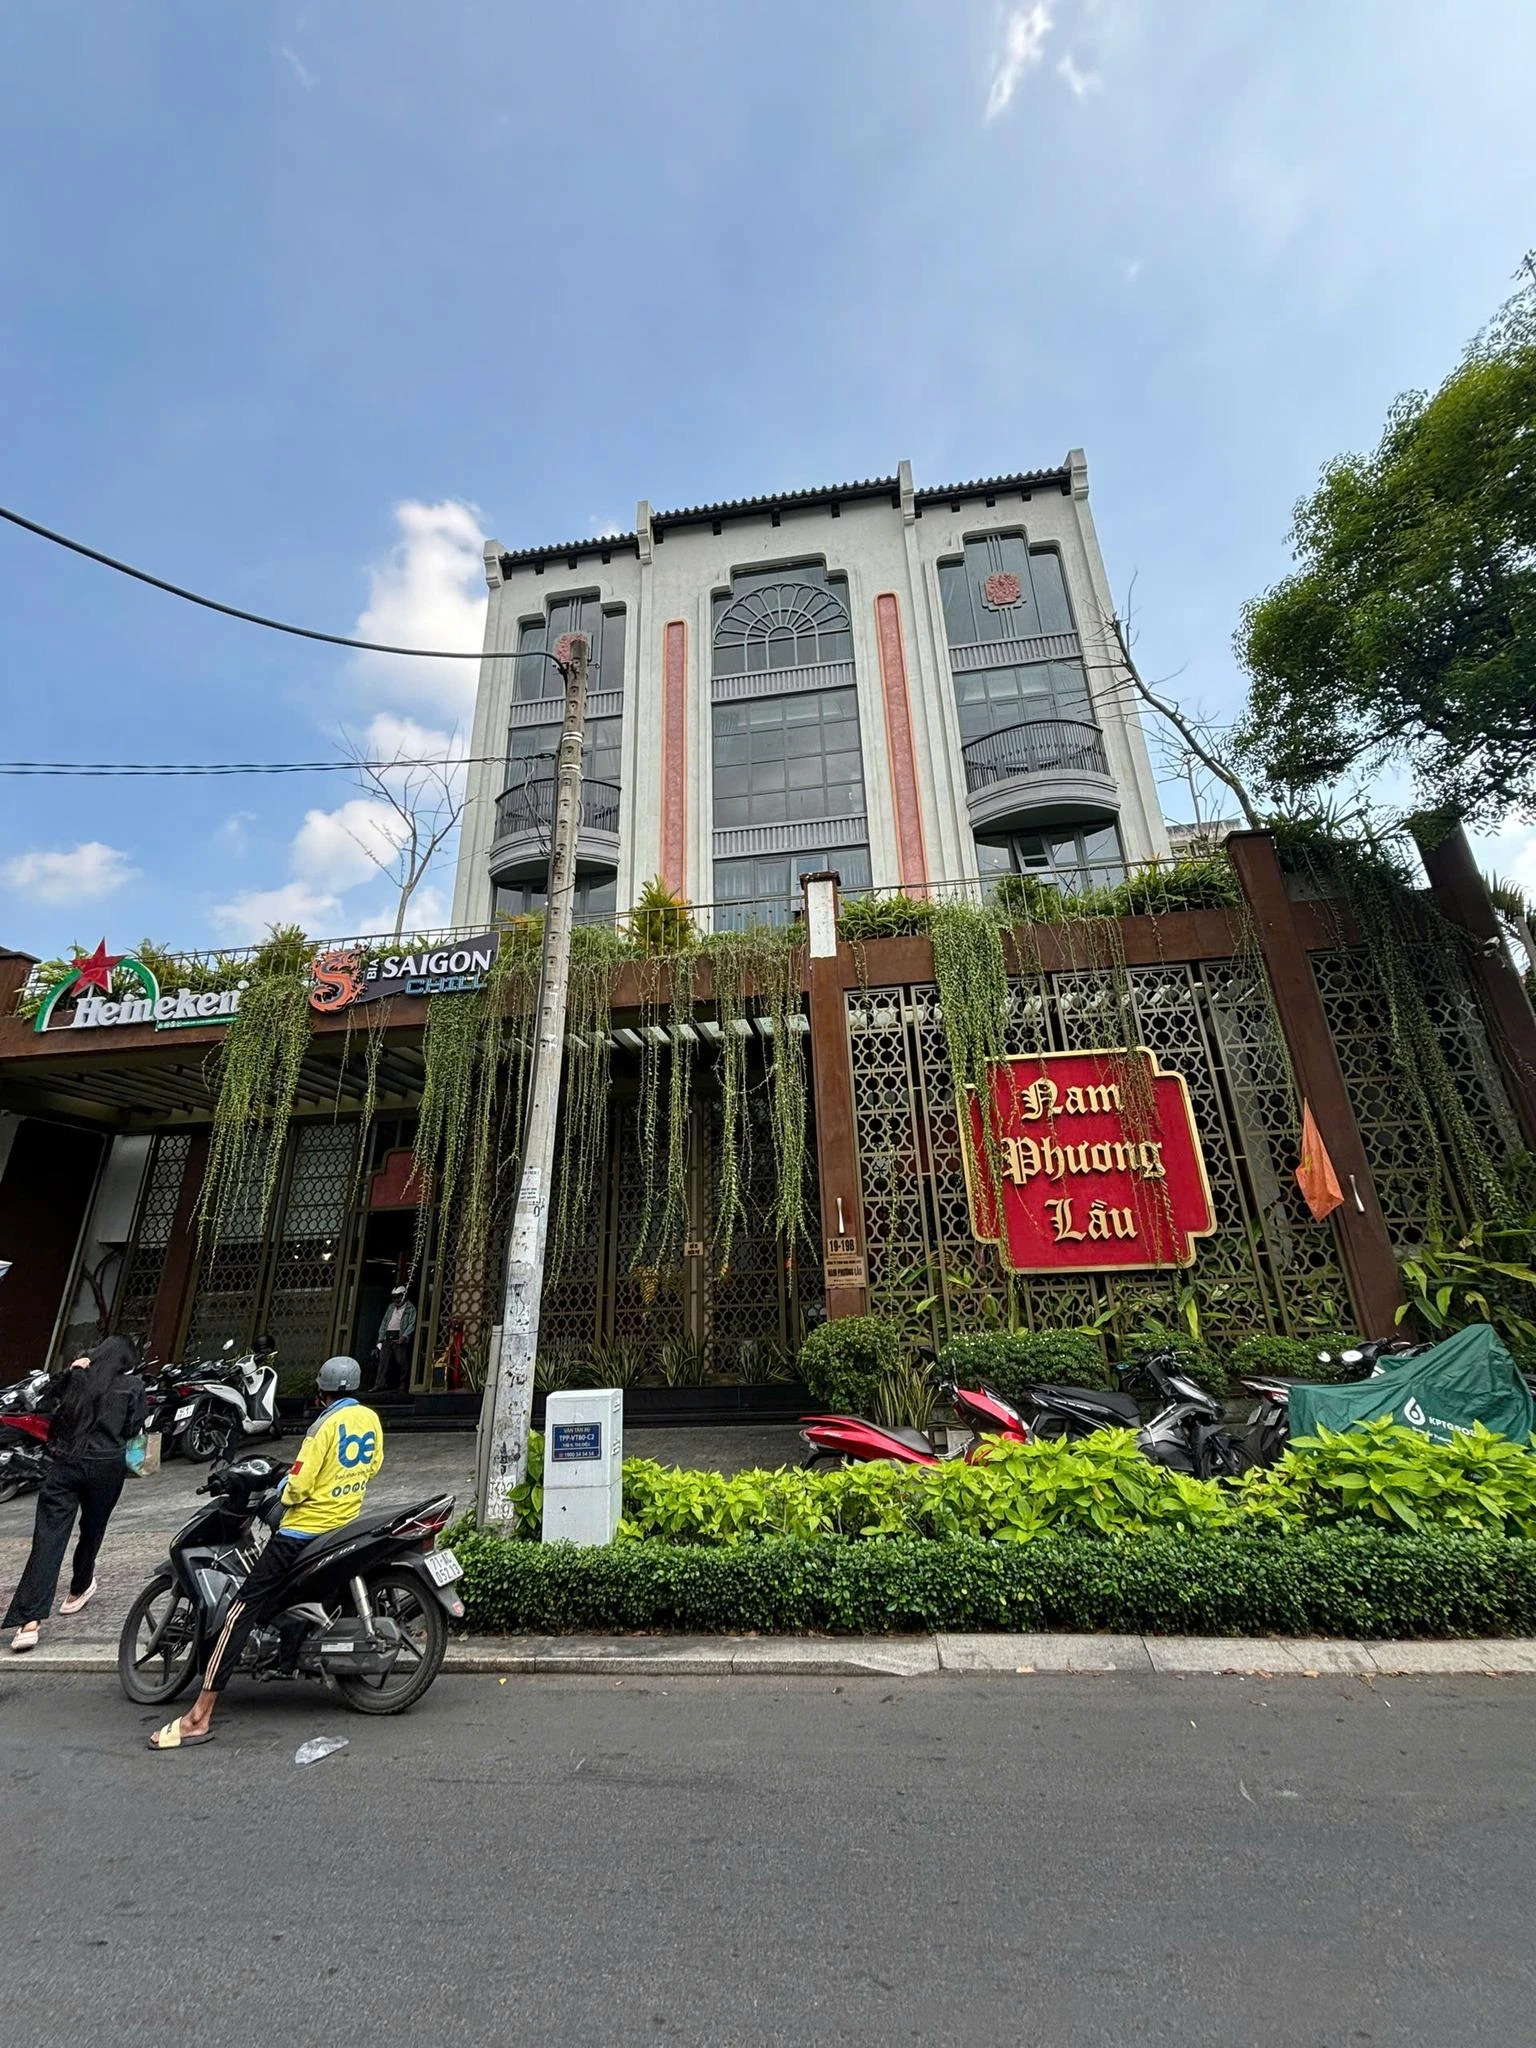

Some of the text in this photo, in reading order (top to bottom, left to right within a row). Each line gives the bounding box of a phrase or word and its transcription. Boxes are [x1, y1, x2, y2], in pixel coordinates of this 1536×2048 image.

[366, 959, 380, 981] BIA
[382, 949, 492, 979] SAIGON
[405, 974, 487, 995] CHILL
[70, 987, 242, 1028] Heineken
[1021, 1076, 1125, 1121] Nam
[1044, 1198, 1138, 1242] Lầu
[338, 1423, 376, 1468] be
